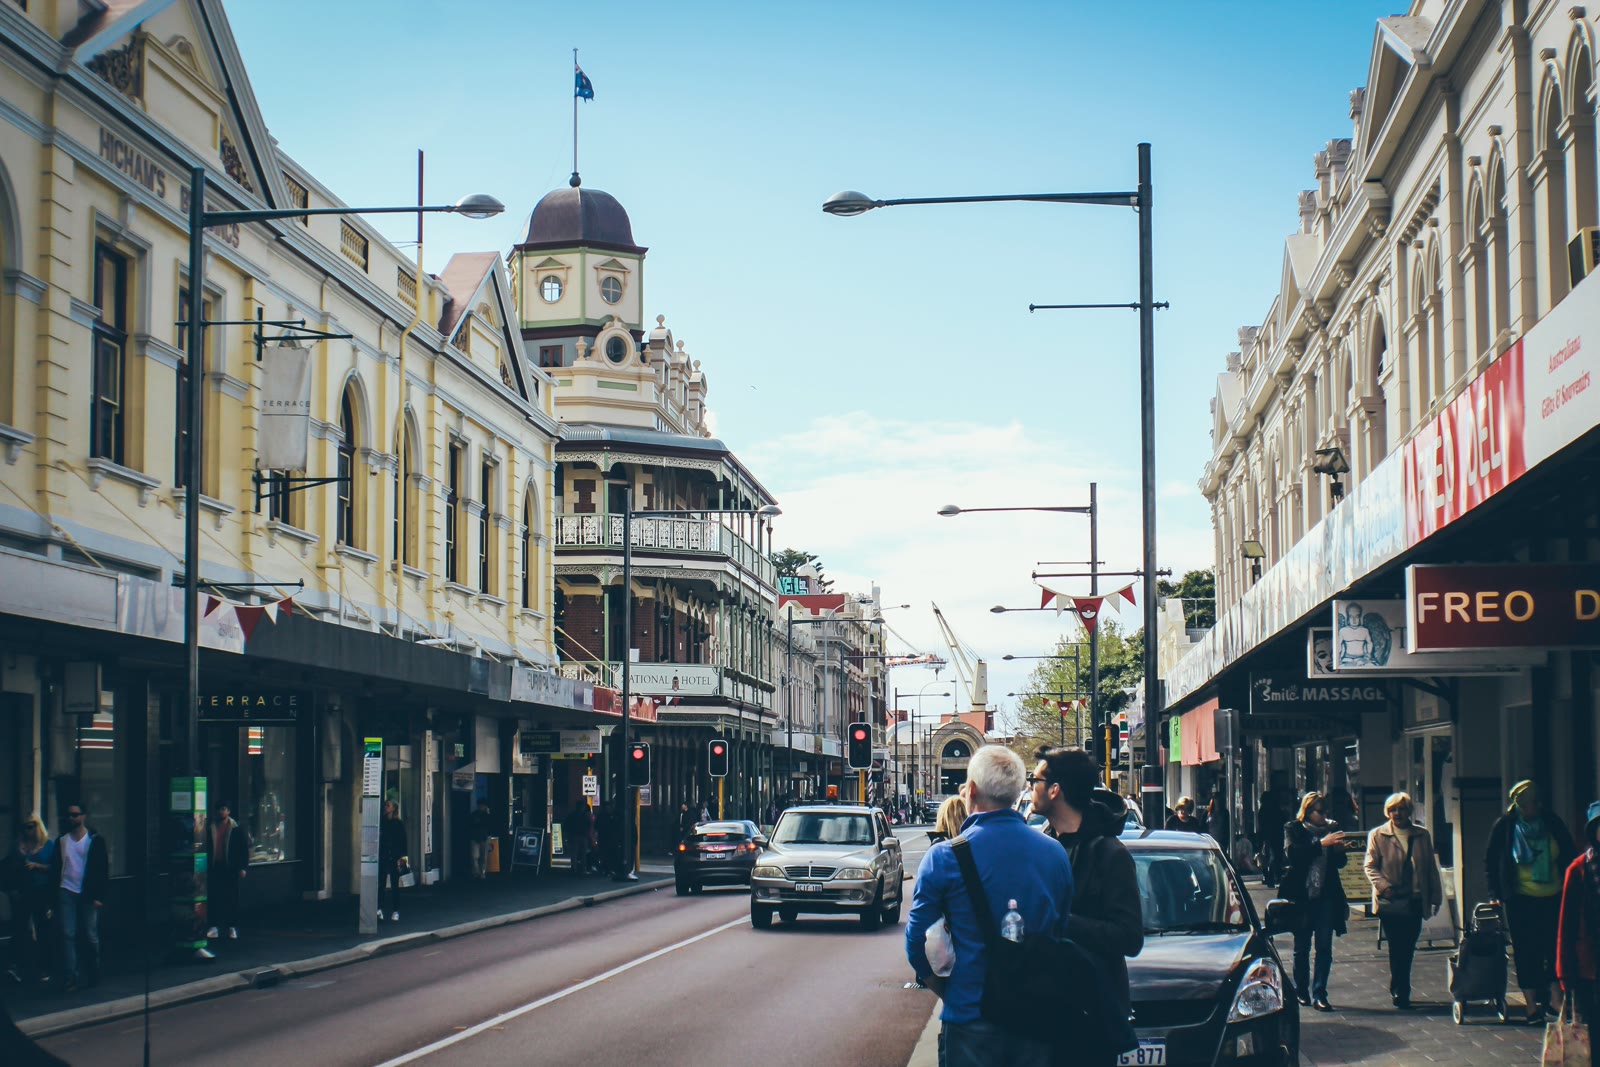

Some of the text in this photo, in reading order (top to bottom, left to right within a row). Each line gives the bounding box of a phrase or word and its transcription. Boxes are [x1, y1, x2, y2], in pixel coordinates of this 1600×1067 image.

[1561, 369, 1591, 406] Souvenirs
[263, 400, 310, 408] TERRACE
[1417, 589, 1535, 624] FREO
[629, 674, 711, 685] ATIONAL HOTEL
[1302, 687, 1385, 701] MASSAGE
[197, 695, 297, 706] TERRACE
